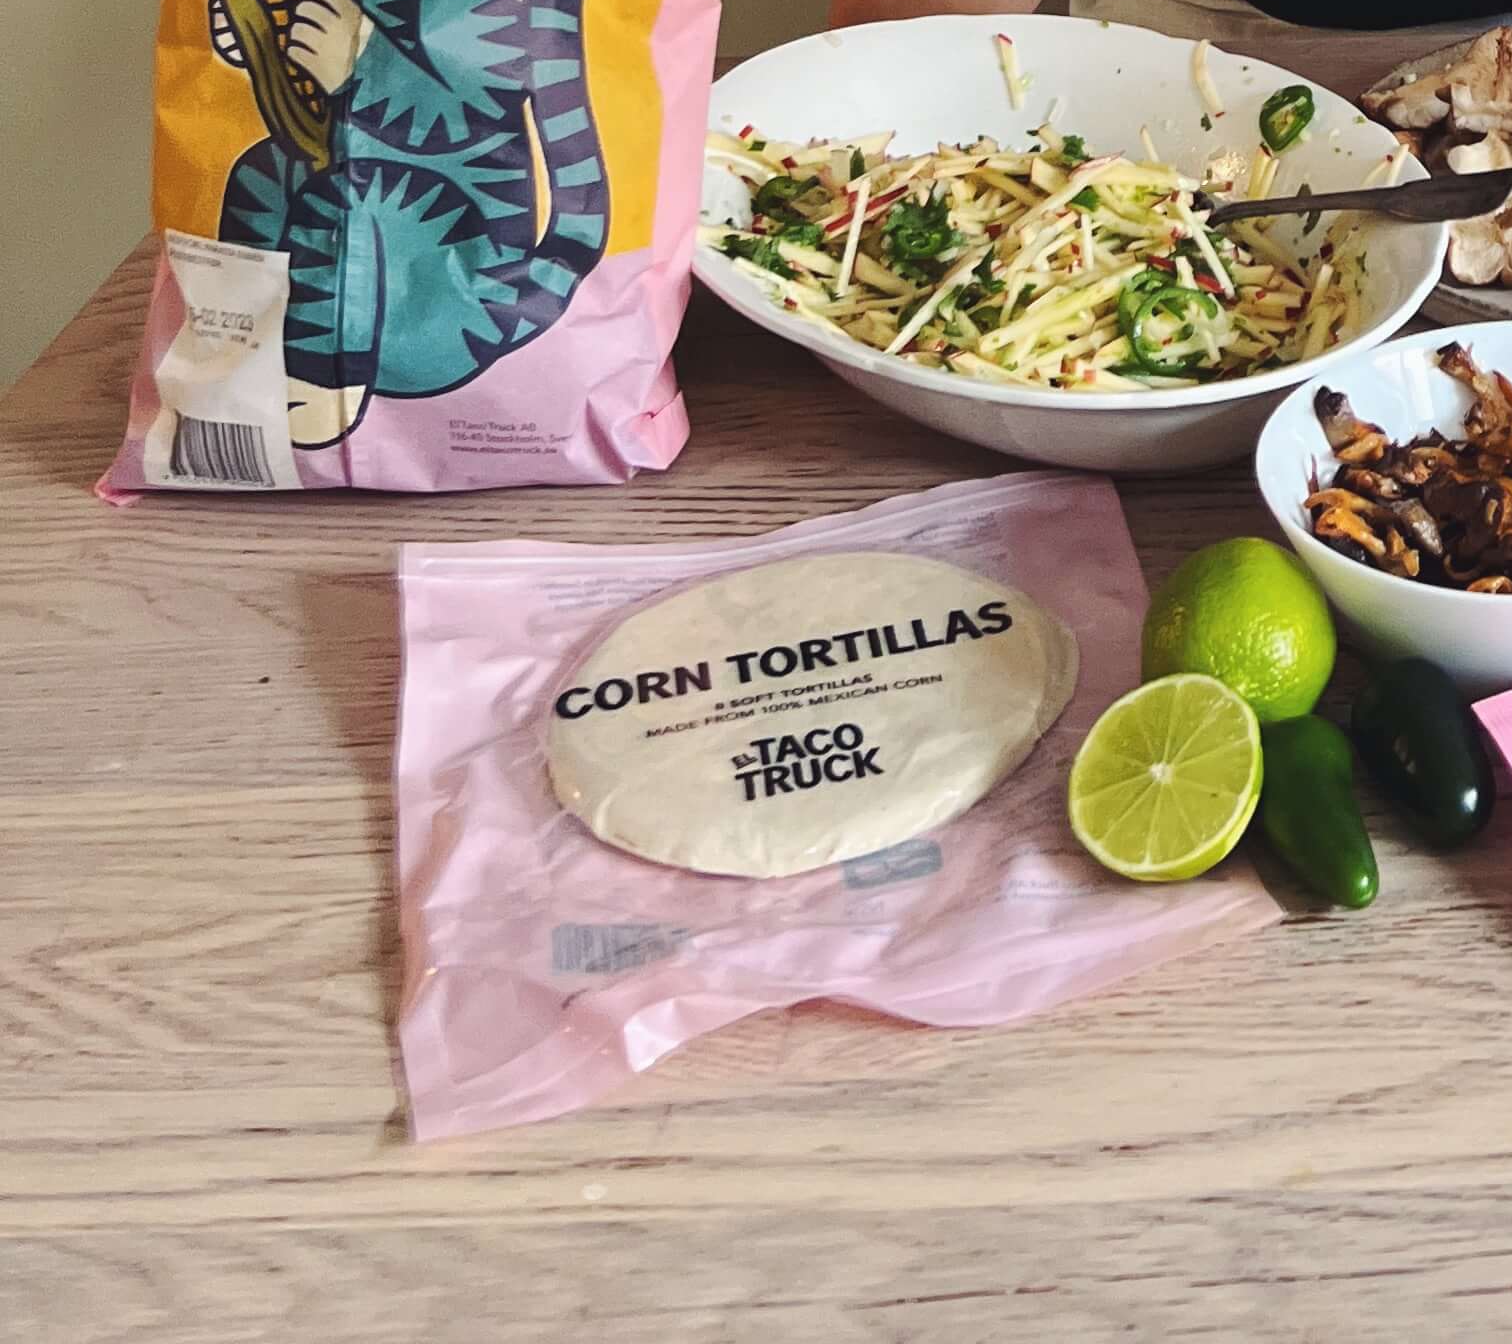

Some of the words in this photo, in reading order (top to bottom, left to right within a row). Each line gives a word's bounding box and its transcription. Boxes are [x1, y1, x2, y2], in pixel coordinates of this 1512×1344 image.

[555, 662, 711, 720] CORN
[725, 601, 1014, 683] TORTILLAS
[645, 719, 698, 739] MADE
[704, 708, 755, 727] FROM
[761, 700, 803, 715] 100%
[808, 683, 889, 708] MEXICAN
[893, 673, 943, 691] CORN
[730, 692, 774, 709] SOFT
[779, 673, 873, 698] TORTILLAS
[730, 753, 758, 770] EL
[750, 723, 864, 767] TACO
[734, 747, 884, 802] TRUCK
